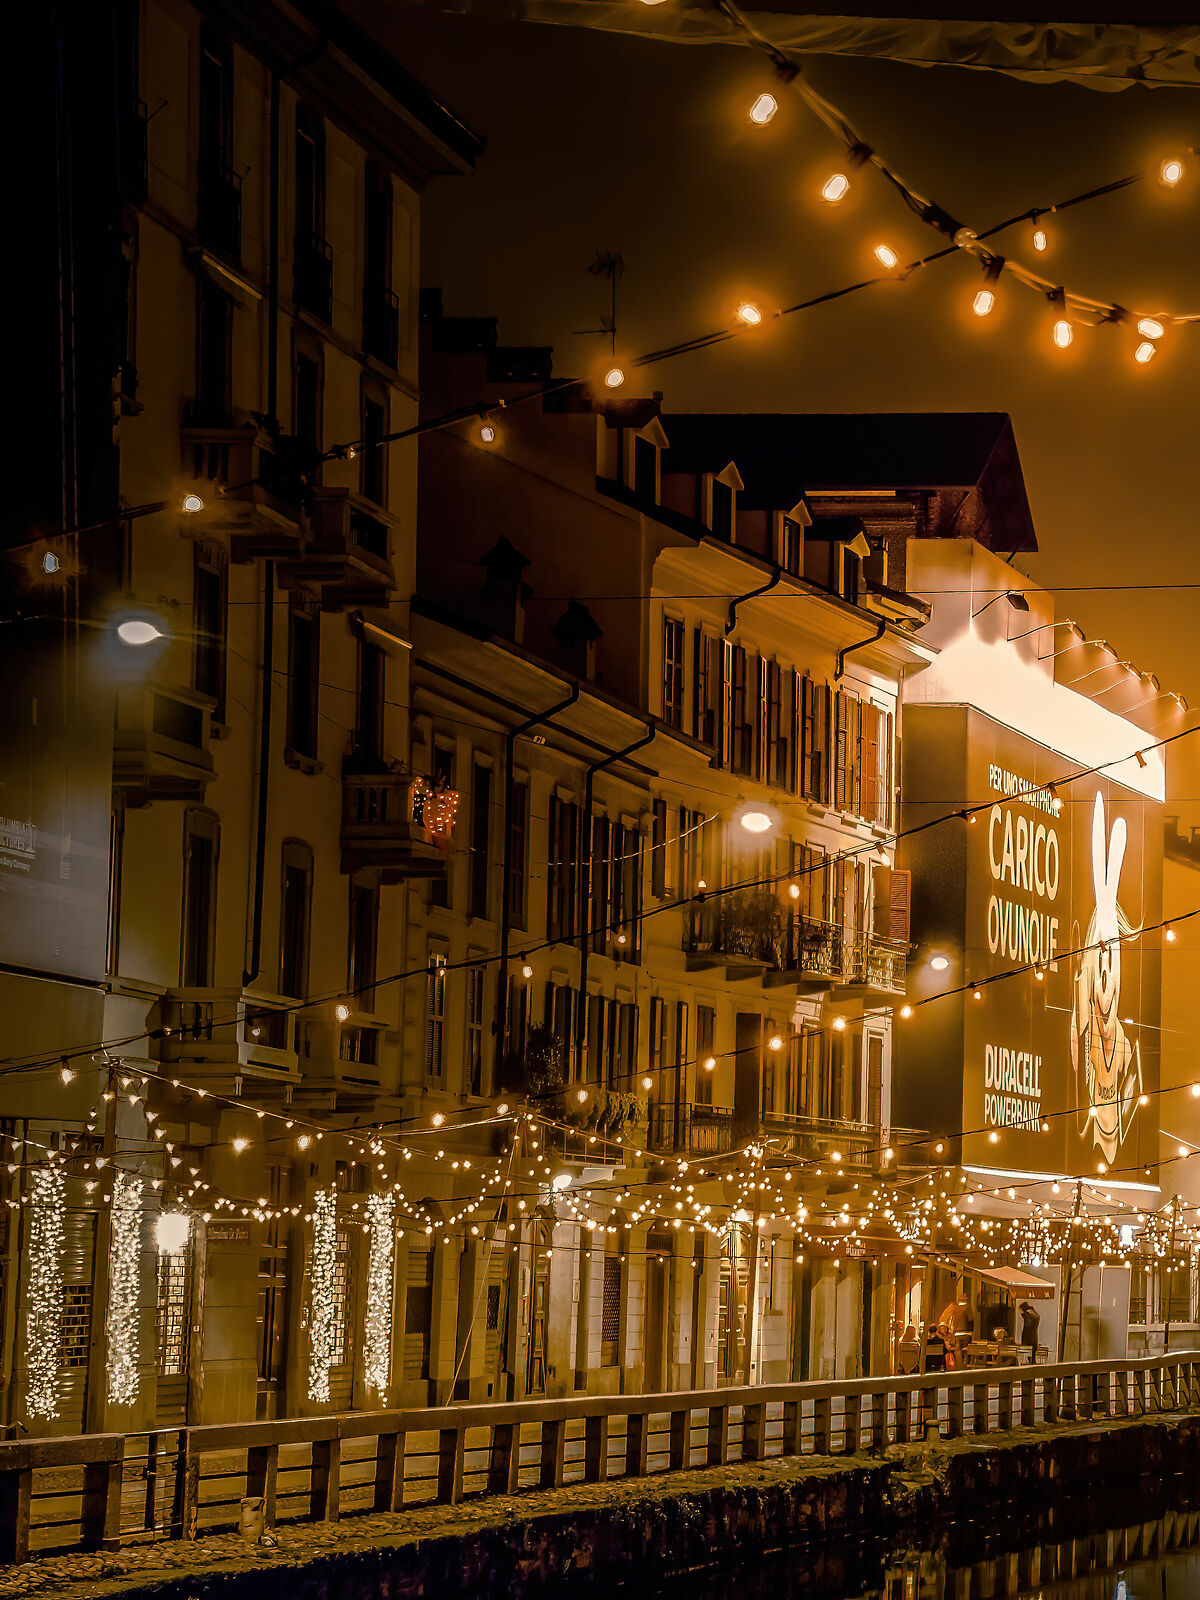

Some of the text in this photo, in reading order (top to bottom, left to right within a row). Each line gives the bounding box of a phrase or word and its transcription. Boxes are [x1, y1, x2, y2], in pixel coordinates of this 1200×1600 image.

[989, 763, 1002, 792] PER
[1003, 770, 1018, 796] UNO
[988, 804, 1059, 900] CARICO
[987, 894, 1059, 973] OVUNQUE
[985, 1043, 1041, 1097] DURACELL
[984, 1093, 1041, 1132] POWERBANK
